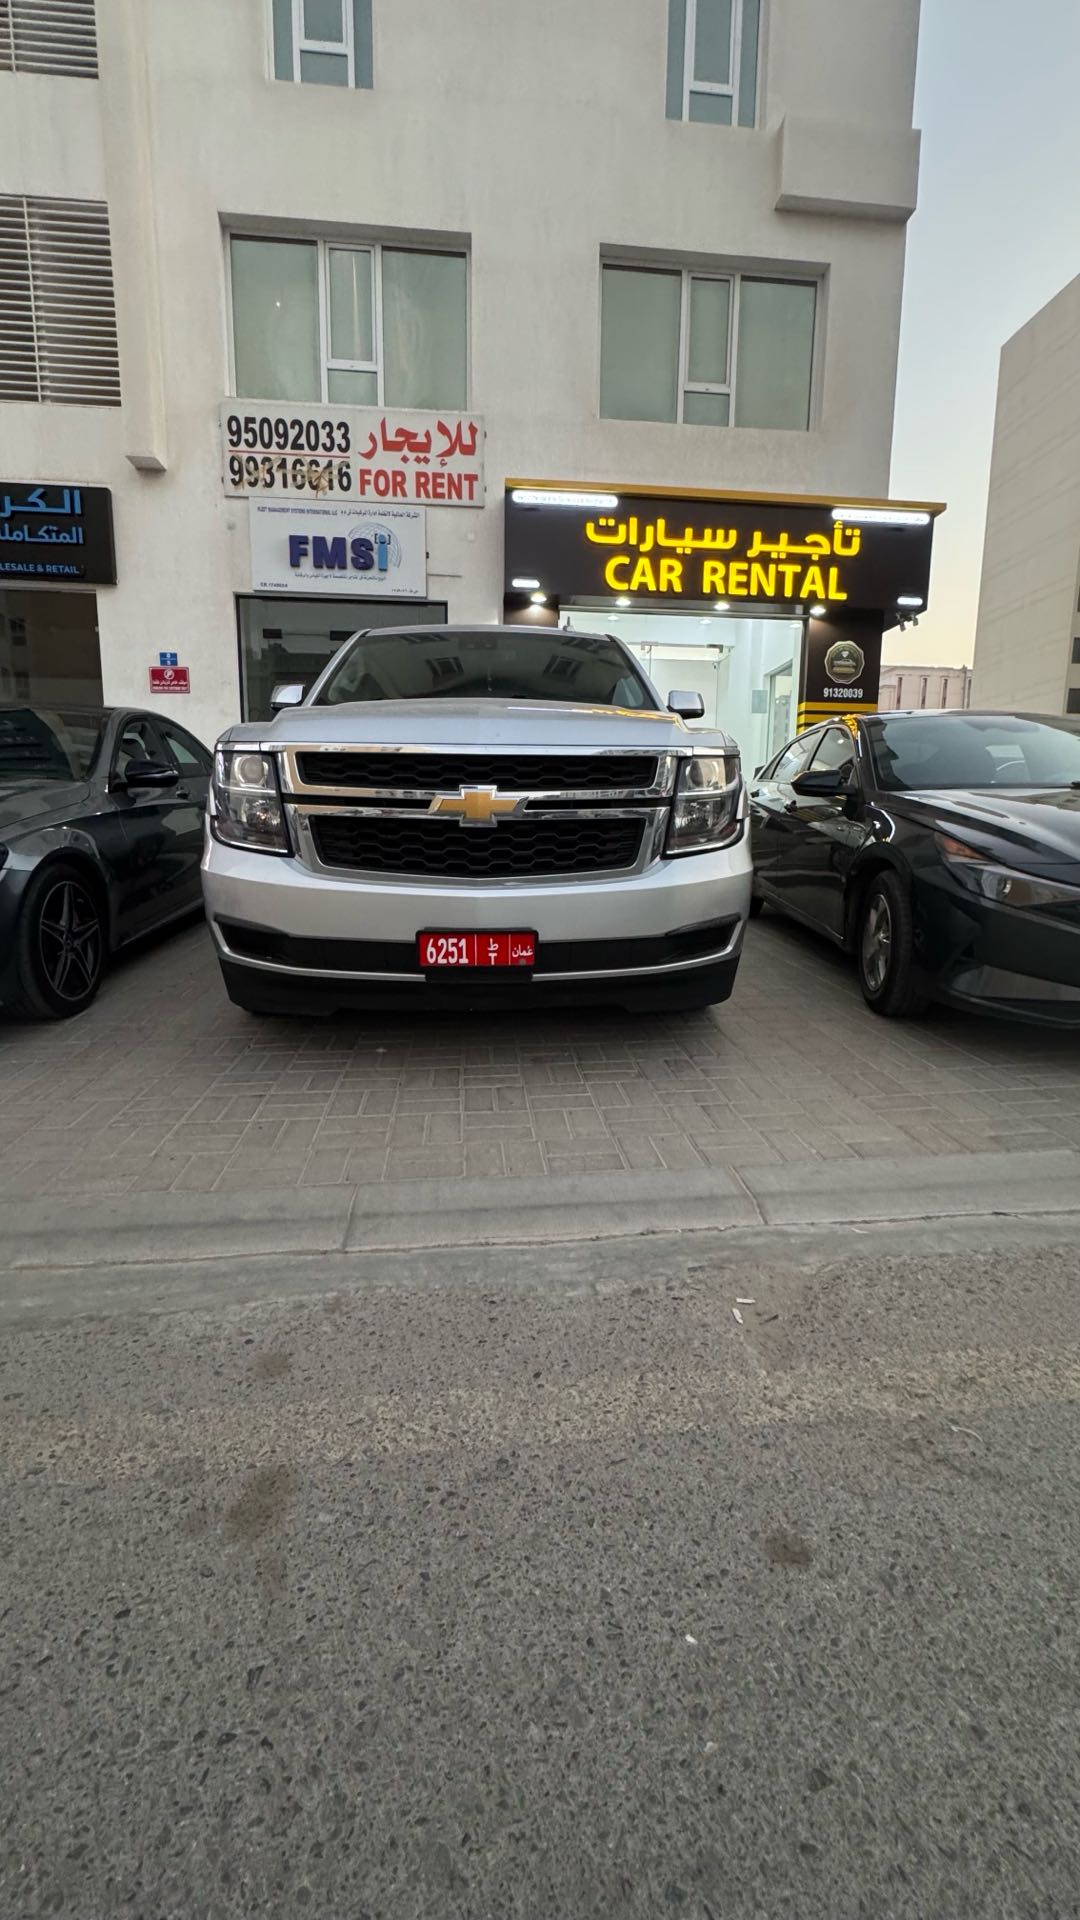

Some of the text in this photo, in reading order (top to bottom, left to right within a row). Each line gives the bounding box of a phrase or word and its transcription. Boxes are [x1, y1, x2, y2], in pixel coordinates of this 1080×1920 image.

[227, 414, 350, 453] 95092033
[358, 416, 478, 468] للإيجار
[229, 454, 351, 492] 99316616
[359, 468, 478, 501] FOR RENT
[585, 516, 861, 559] تأجير سيارات
[46, 564, 80, 573] RETAIL
[604, 556, 849, 601] CAR RENTAL
[823, 687, 864, 698] 91320039
[426, 938, 469, 964] 6251
[487, 938, 499, 951] ط
[488, 952, 498, 966] T
